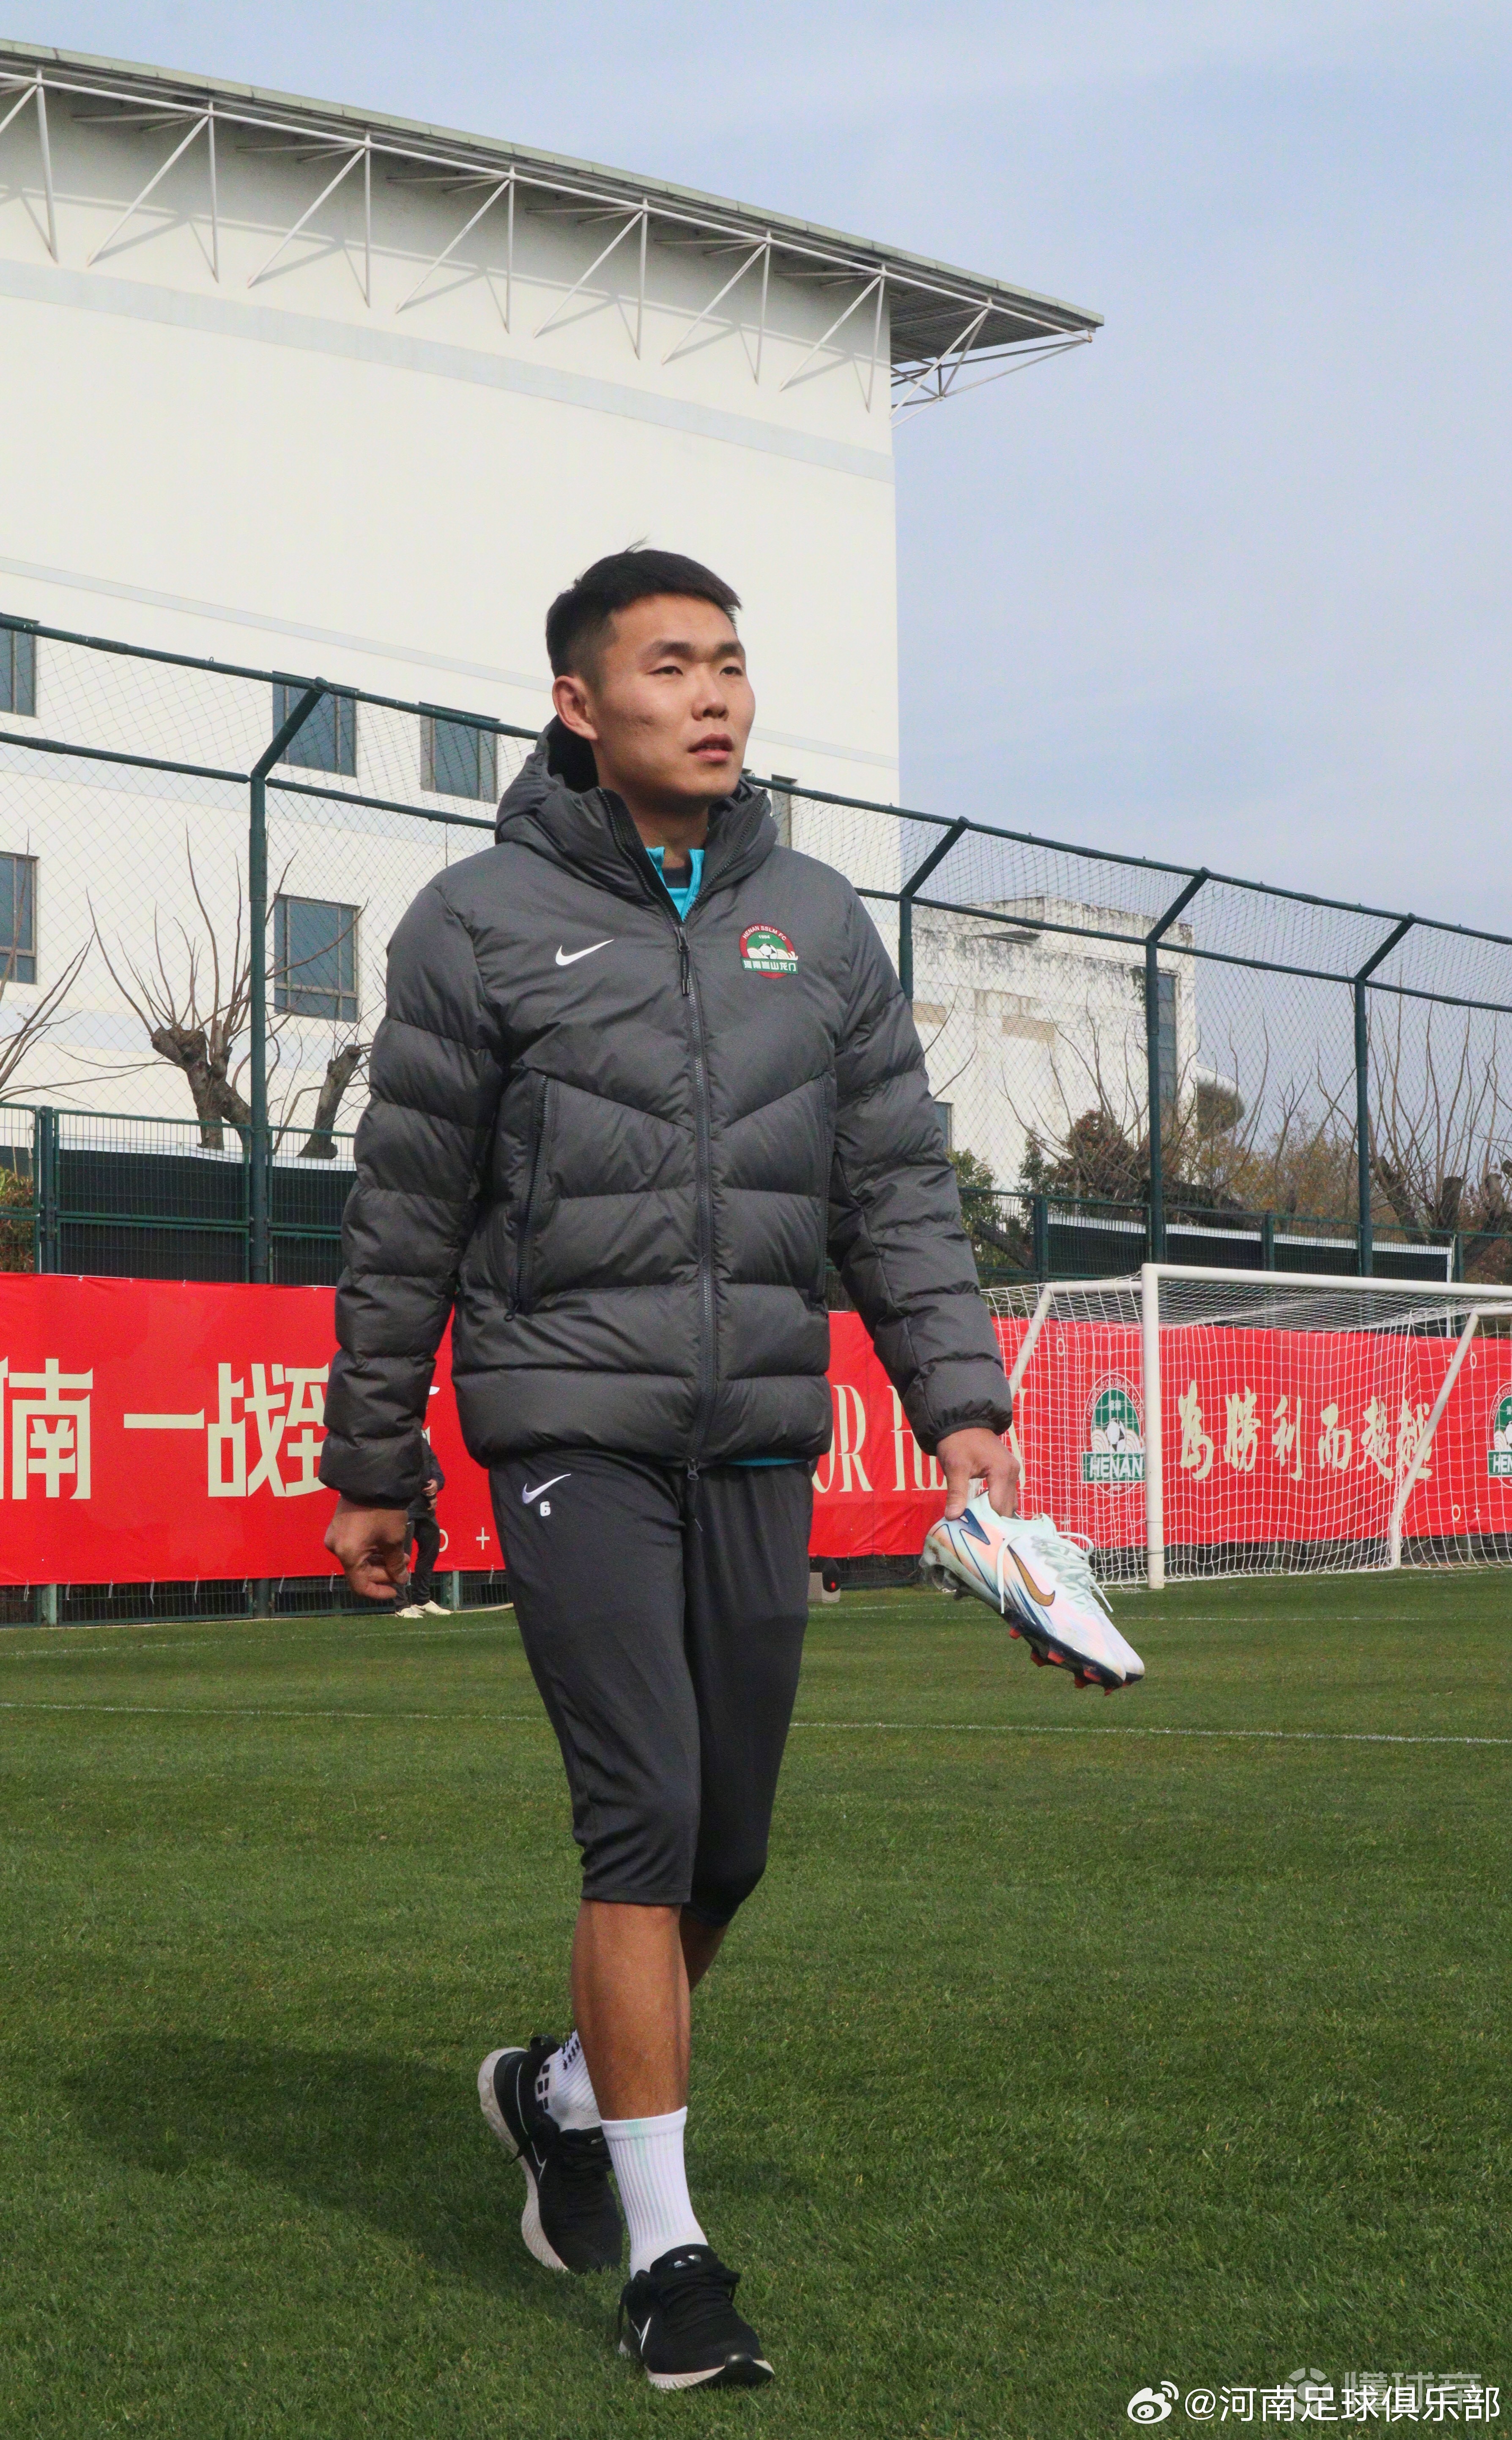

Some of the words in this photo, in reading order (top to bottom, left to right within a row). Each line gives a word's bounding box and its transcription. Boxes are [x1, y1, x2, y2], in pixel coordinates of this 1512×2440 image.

[742, 926, 760, 939] HENAN
[761, 926, 778, 934] SSLM
[778, 932, 787, 941] FC
[0, 1356, 93, 1500] 南
[1089, 1456, 1142, 1478] HENAN
[540, 1501, 551, 1517] 6
